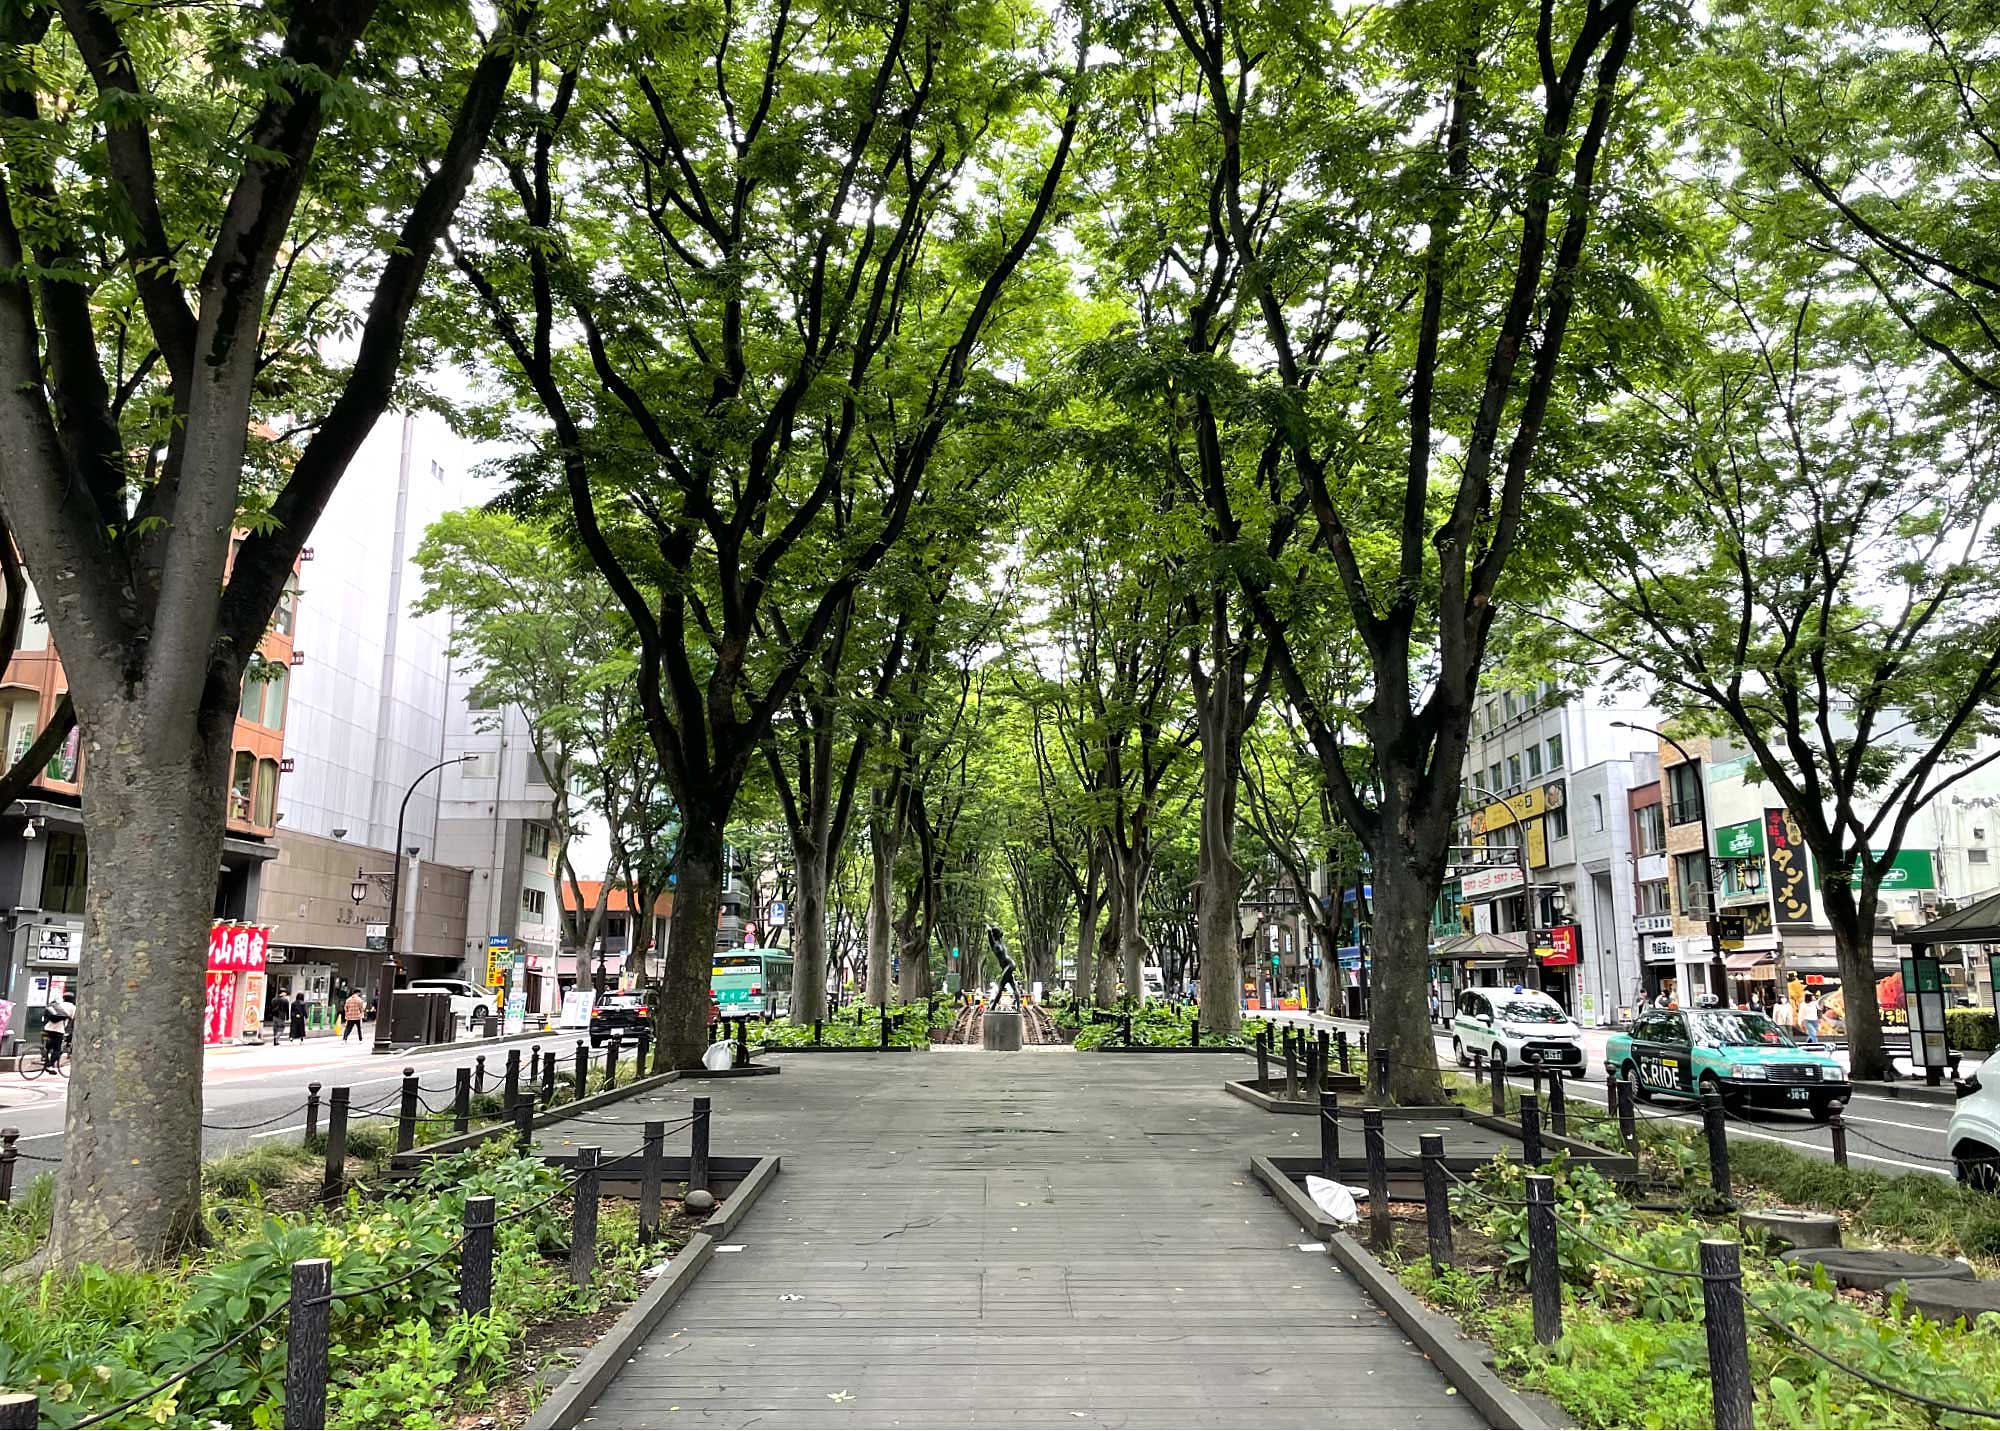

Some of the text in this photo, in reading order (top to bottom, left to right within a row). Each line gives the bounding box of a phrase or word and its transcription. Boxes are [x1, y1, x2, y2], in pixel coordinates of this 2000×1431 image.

[1772, 847, 1808, 919] タンメン
[1641, 1063, 1682, 1090] S.RIDE
